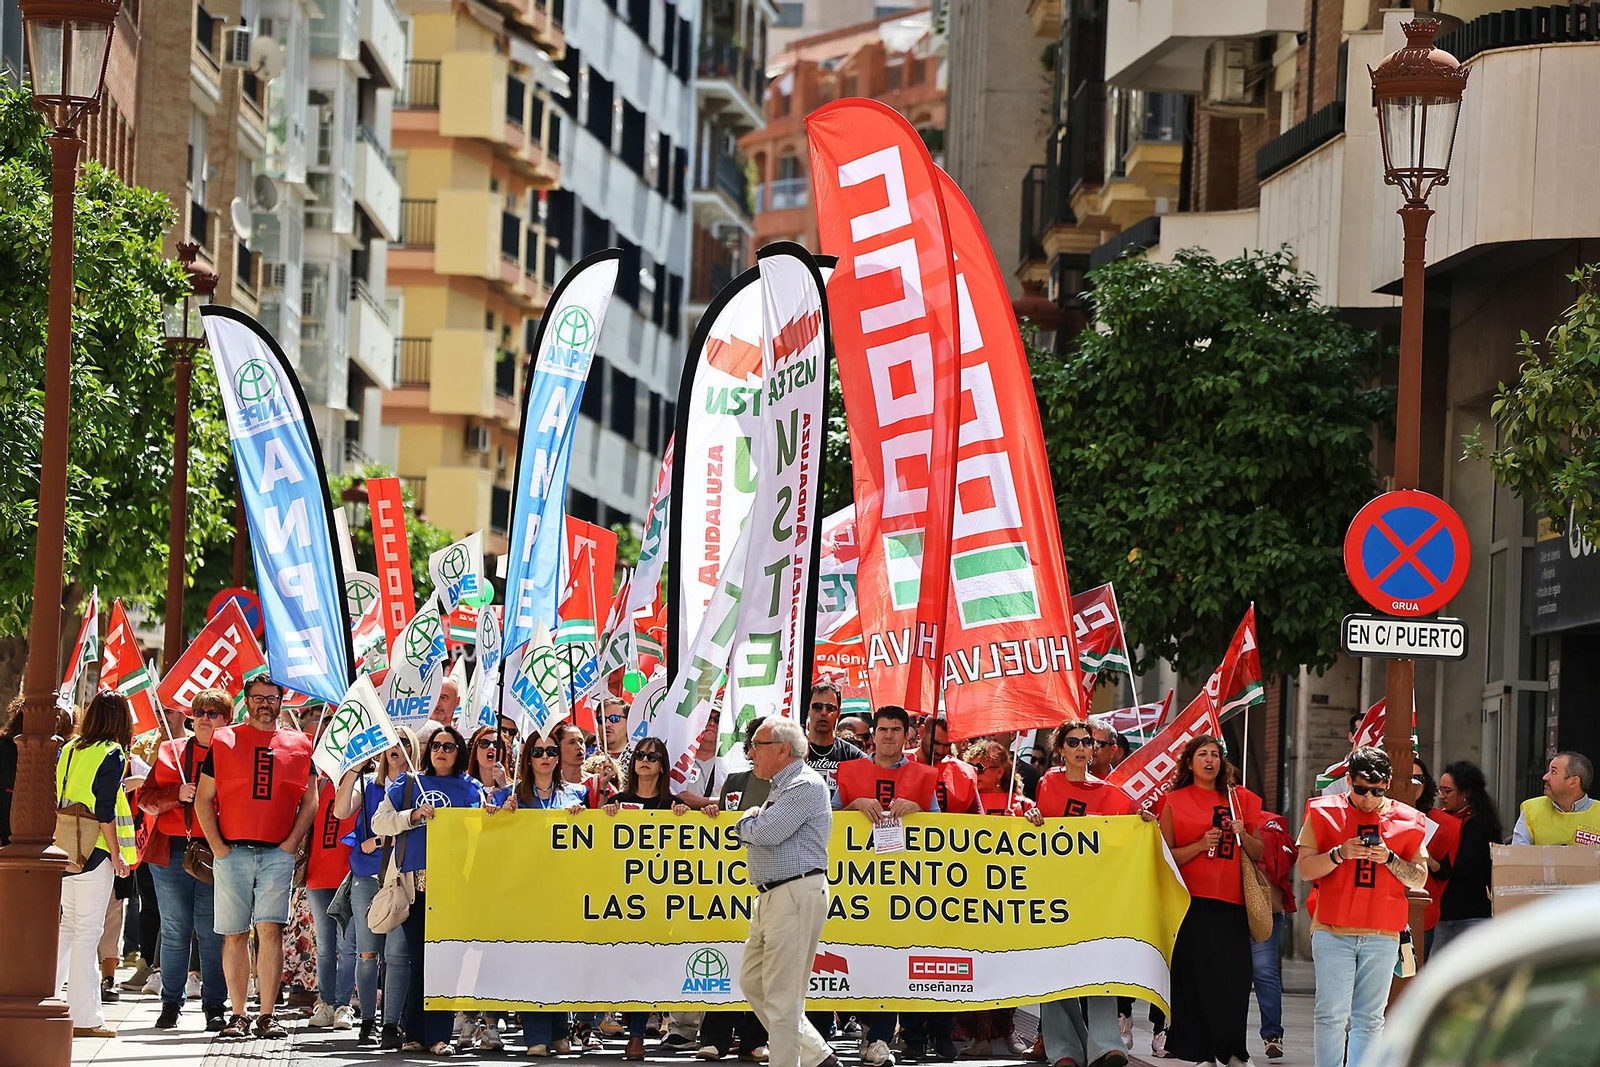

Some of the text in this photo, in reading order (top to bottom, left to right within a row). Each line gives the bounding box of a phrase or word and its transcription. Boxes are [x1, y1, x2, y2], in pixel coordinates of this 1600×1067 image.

[1391, 601, 1419, 611] GRUA
[1349, 624, 1462, 649] EN C/ PUERTO
[386, 696, 432, 716] ANPE
[551, 824, 593, 850] EN
[613, 824, 743, 850] DEFENS
[905, 824, 1100, 857] EDUCACIÓN
[625, 853, 1027, 891] PÚBLIC UMENTO DE
[583, 894, 646, 920] LAS
[889, 894, 1070, 924] DOCENTES
[682, 978, 731, 991] ANPE
[807, 977, 850, 992] STEA
[908, 981, 973, 993] enseñanza
